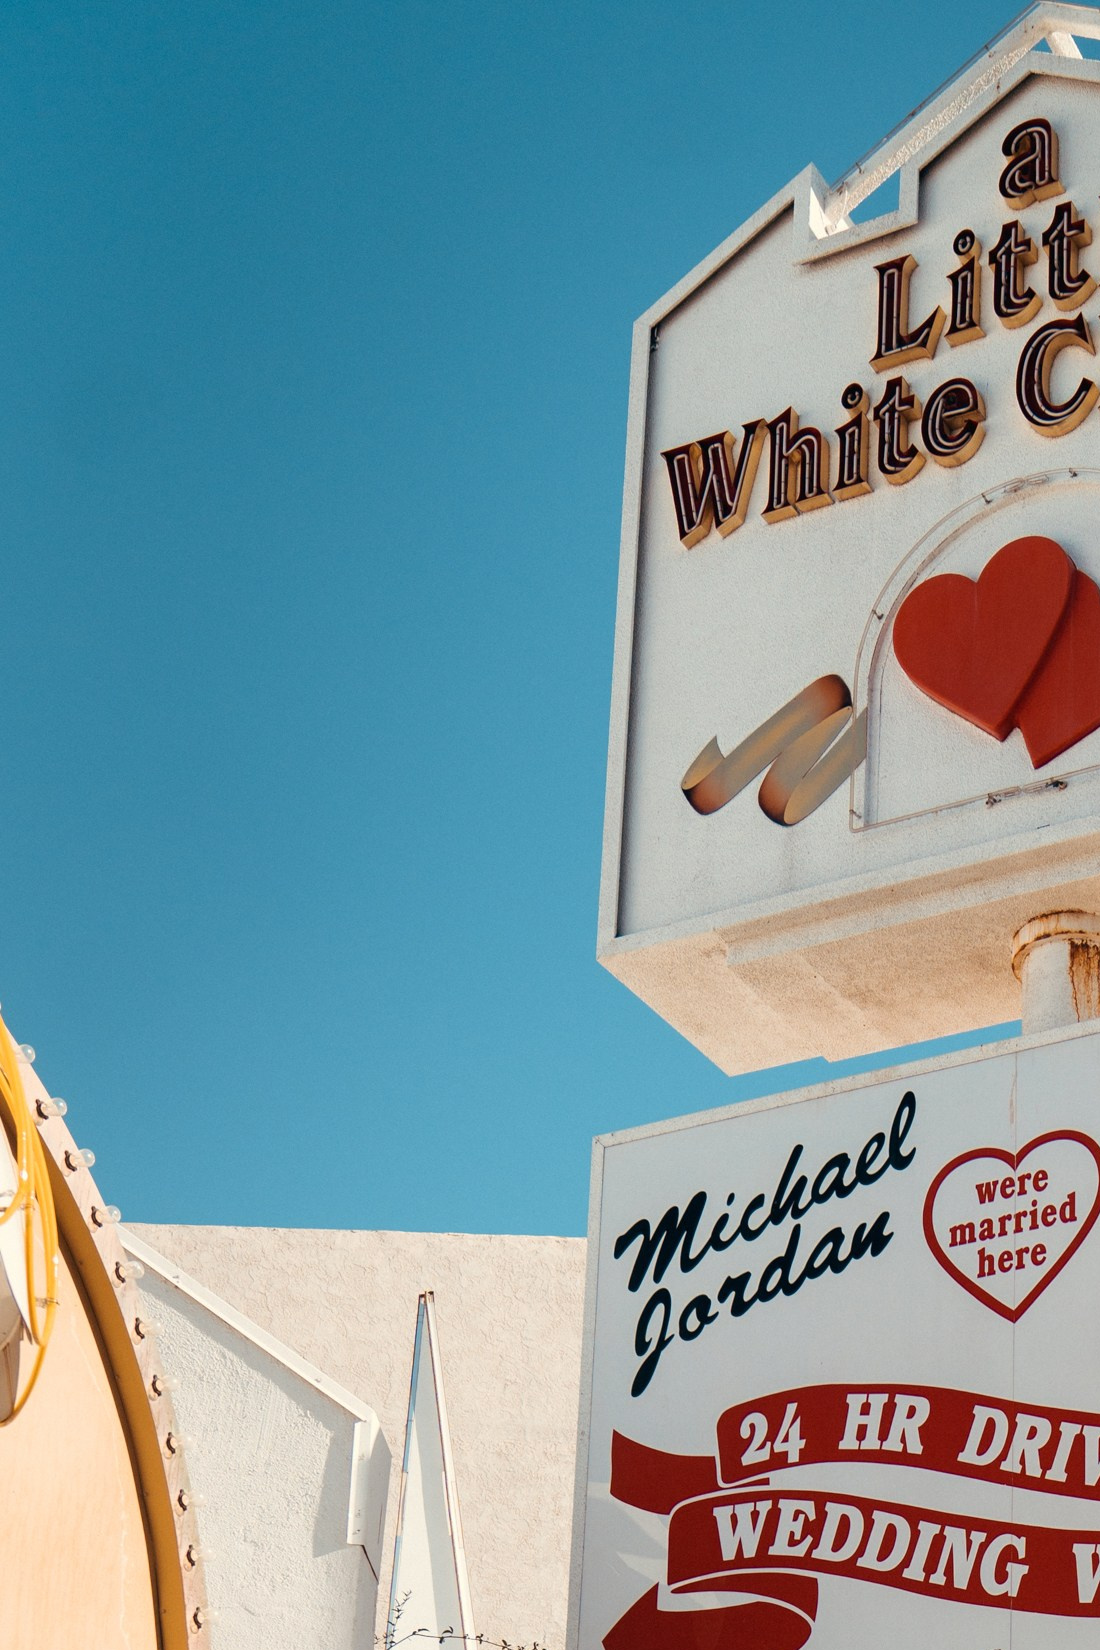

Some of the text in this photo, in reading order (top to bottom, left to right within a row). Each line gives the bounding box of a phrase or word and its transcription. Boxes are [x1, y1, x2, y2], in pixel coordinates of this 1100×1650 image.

[999, 117, 1065, 209] a
[662, 375, 987, 550] White
[613, 1090, 918, 1293] Michael
[948, 1198, 1078, 1247] married
[975, 1164, 1049, 1201] were
[630, 1210, 896, 1398] Jordan
[977, 1239, 1047, 1279] here
[739, 1402, 806, 1467] 24
[840, 1392, 931, 1455] HR
[713, 1500, 1030, 1599] WEDDING
